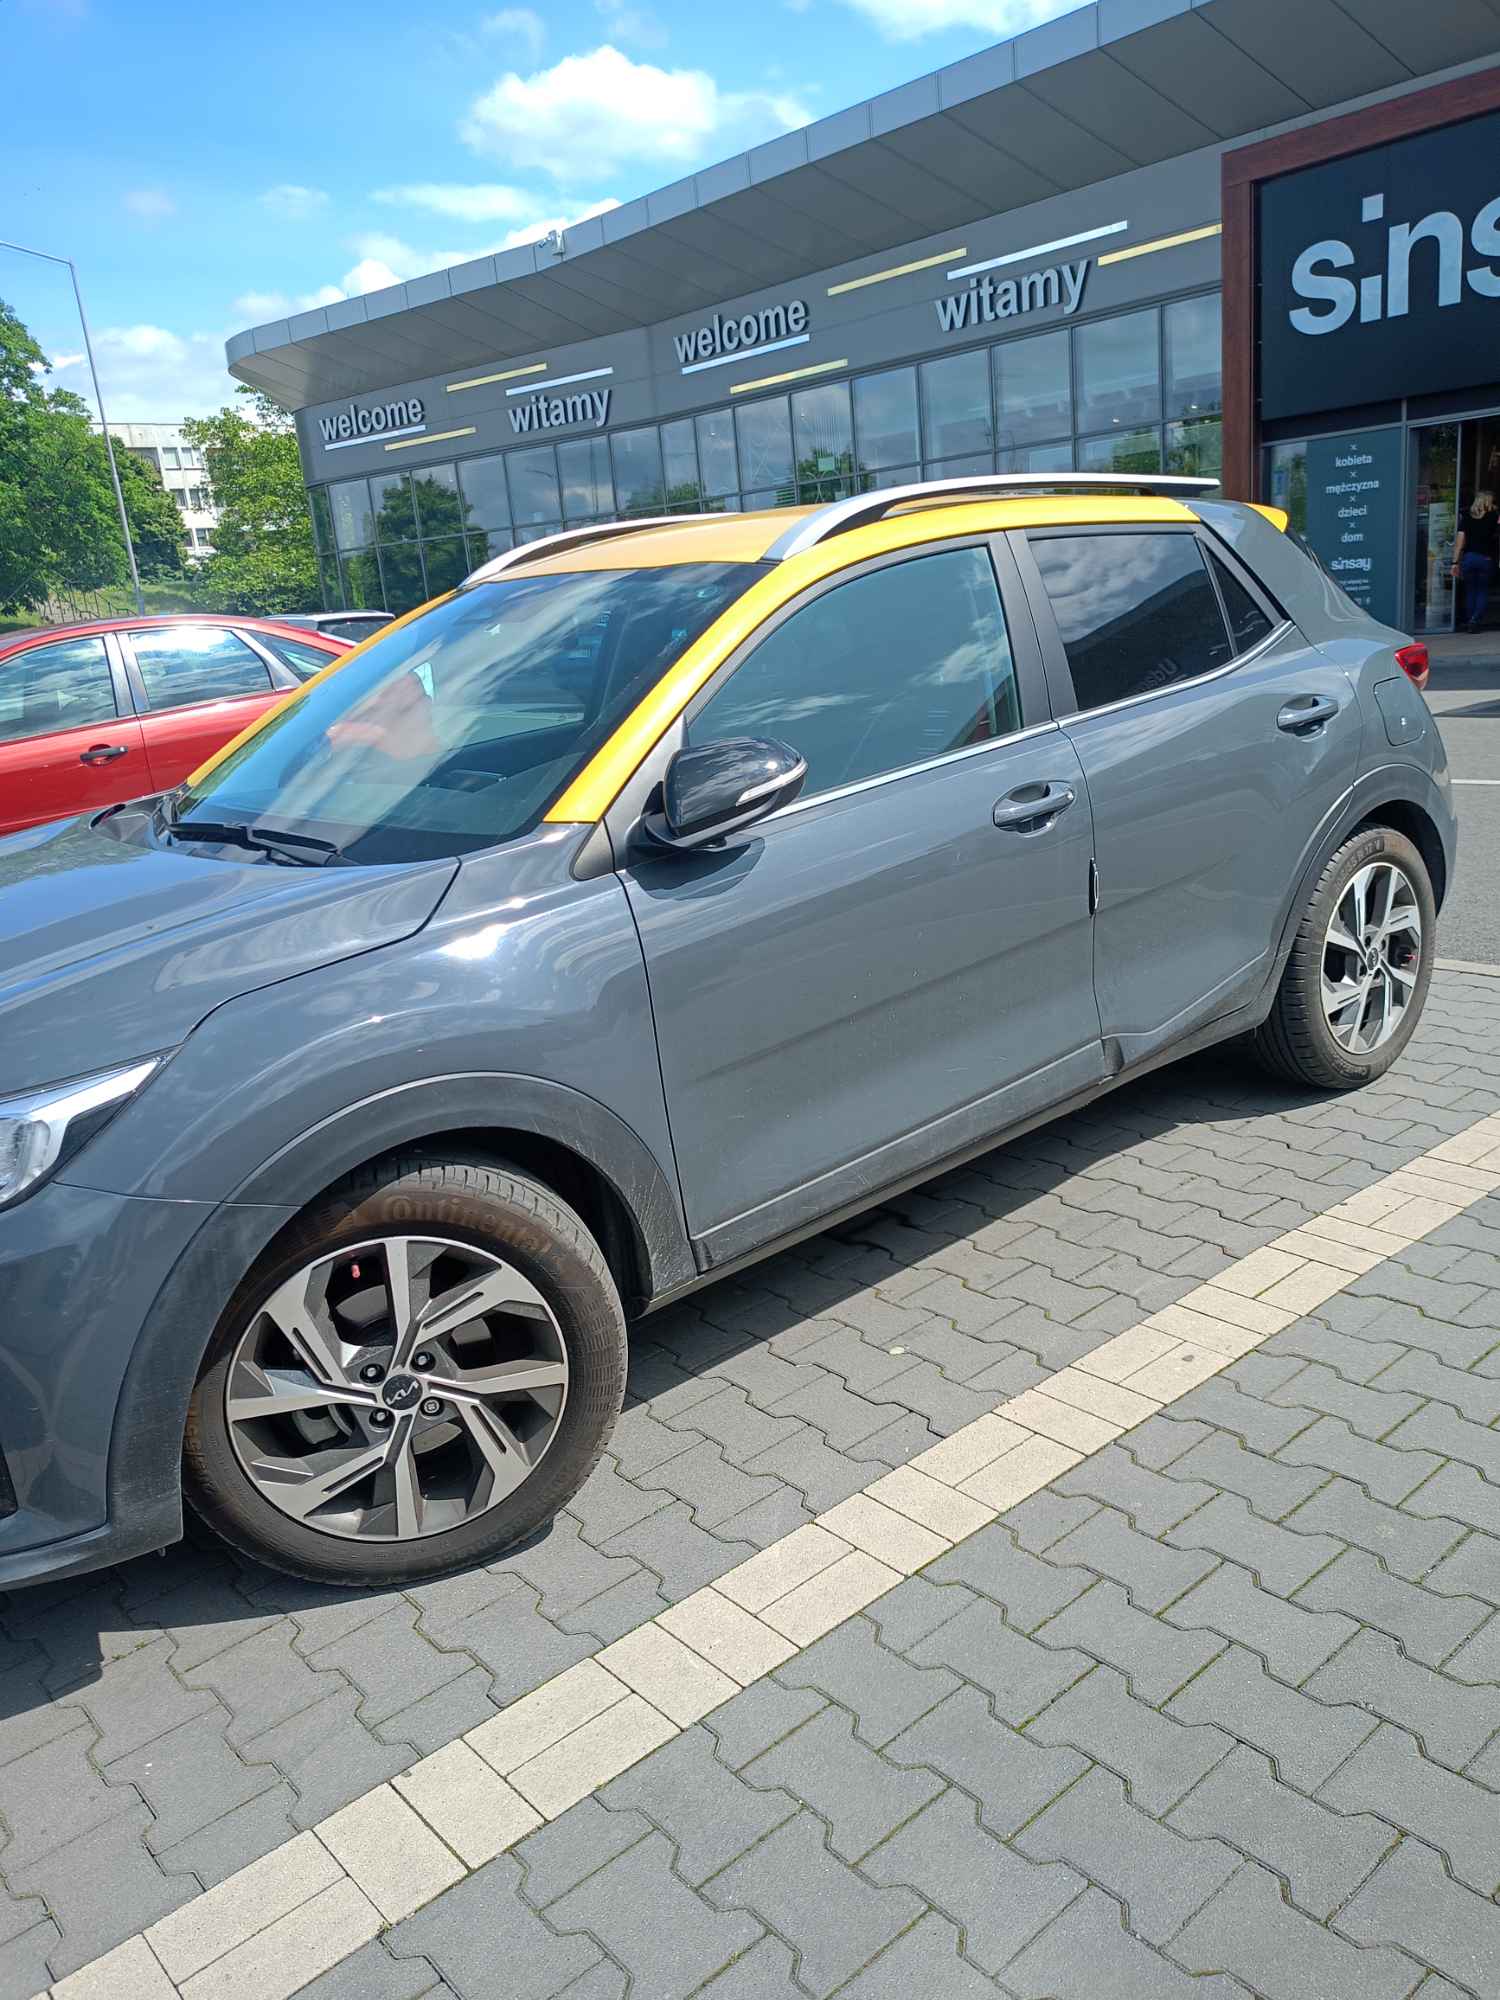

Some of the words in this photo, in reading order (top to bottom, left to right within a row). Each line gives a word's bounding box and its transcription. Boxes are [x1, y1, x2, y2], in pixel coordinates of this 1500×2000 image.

[936, 259, 1090, 332] witamy
[674, 300, 808, 363] welcome
[319, 397, 424, 441] welcome
[508, 389, 611, 433] witamy
[1335, 454, 1372, 467] kobieta
[1337, 505, 1367, 518] dzieci
[1341, 532, 1363, 543] dom
[1331, 557, 1371, 571] sinsay
